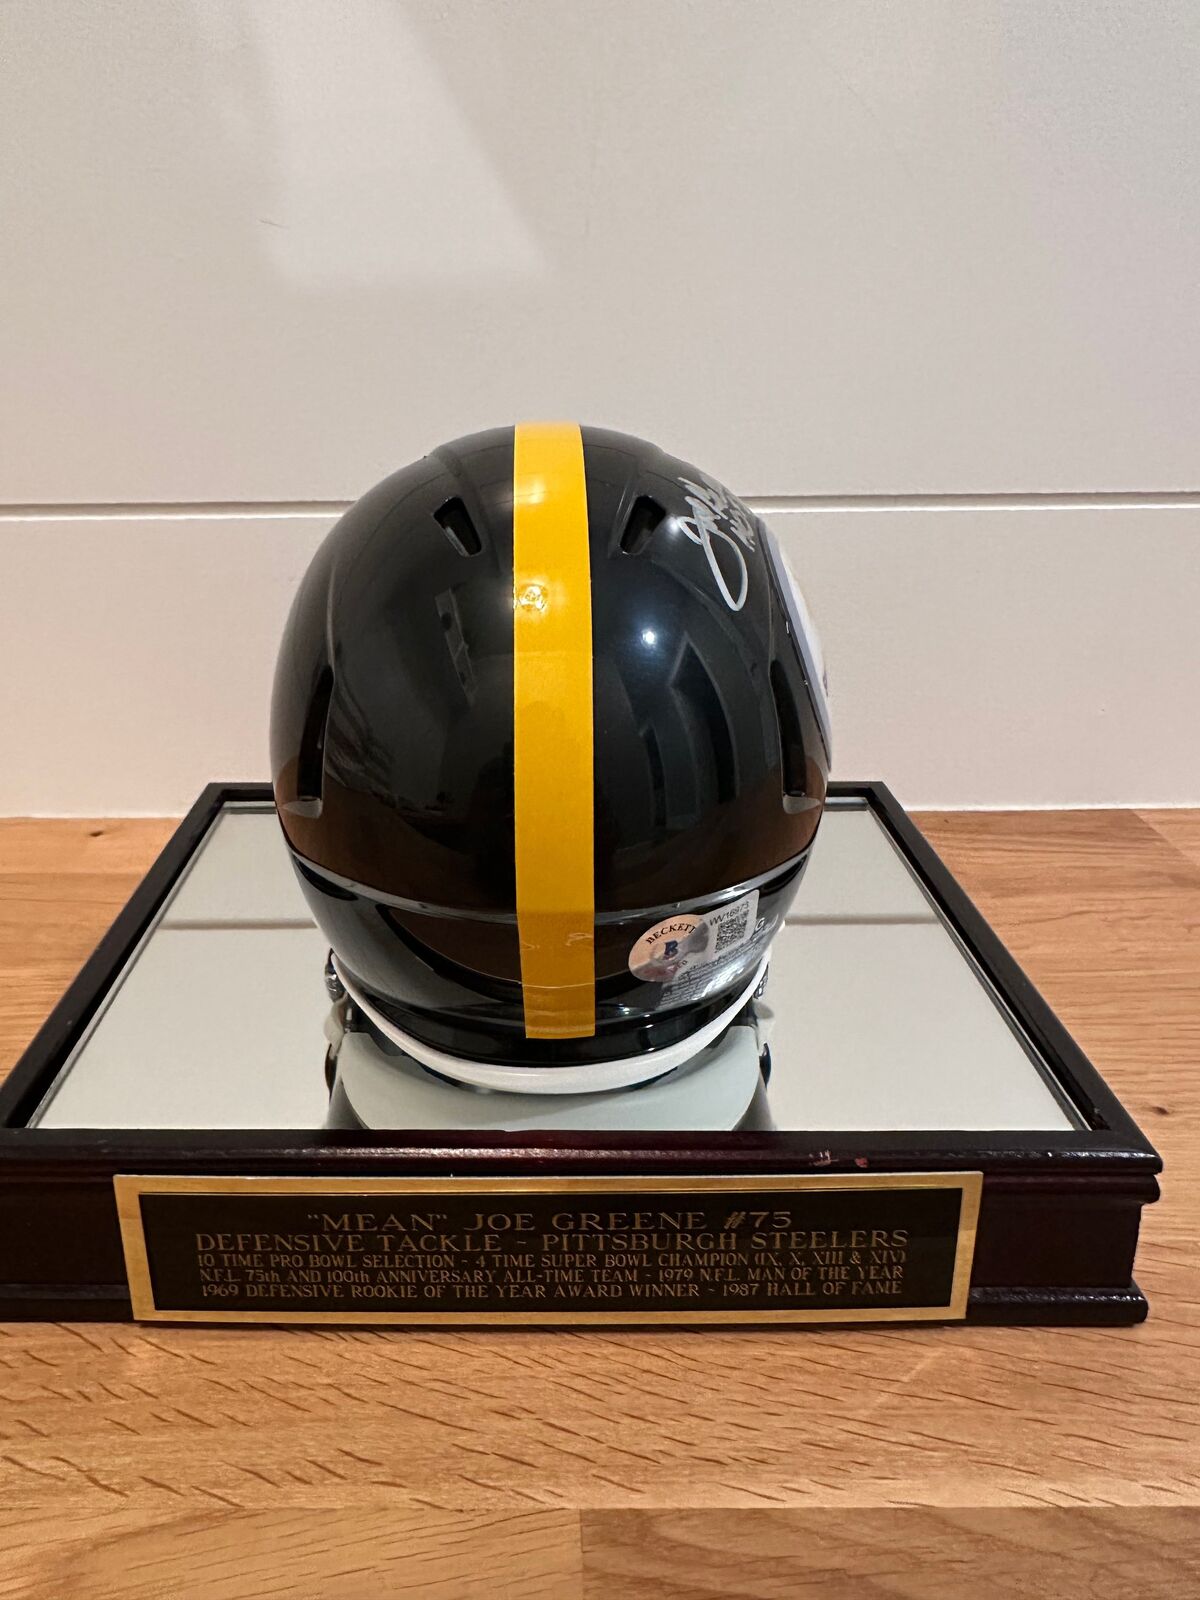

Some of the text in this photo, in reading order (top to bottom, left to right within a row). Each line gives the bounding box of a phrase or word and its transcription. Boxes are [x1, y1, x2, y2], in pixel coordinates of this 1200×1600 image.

[645, 922, 696, 945] BECKETT
[464, 1213, 535, 1231] JOE
[552, 1212, 707, 1230] GREENE
[724, 1211, 792, 1229] #75
[195, 1233, 364, 1252] DEFENSIVE
[377, 1234, 502, 1252] TACKLE
[542, 1232, 737, 1251] PITTSBURGH
[751, 1229, 909, 1249] STEELERS
[198, 1254, 215, 1267] 10
[222, 1254, 264, 1267] TIME
[270, 1254, 303, 1267] PRO
[309, 1255, 357, 1267] BOWL
[362, 1255, 455, 1268] SELECTION
[476, 1255, 486, 1267] 4
[492, 1254, 535, 1267] TIME
[541, 1254, 597, 1267] SUPER
[605, 1254, 652, 1267] BOWL
[658, 1252, 748, 1267] CHAMPION
[813, 1251, 843, 1265] XIII
[849, 1252, 861, 1264] &
[246, 1270, 280, 1282] 75th
[288, 1270, 321, 1282] AND
[328, 1270, 369, 1282] 100th
[377, 1270, 497, 1283] ANNIVERSARY
[504, 1269, 584, 1283] ALL-TIME
[591, 1269, 638, 1282] TEAM
[659, 1269, 693, 1282] 1979
[748, 1267, 785, 1280] MAN
[791, 1267, 812, 1280] OF
[818, 1266, 850, 1279] THE
[858, 1265, 904, 1279] YEAR
[202, 1284, 238, 1297] 1969
[246, 1284, 344, 1297] DEFENSIVE
[352, 1285, 418, 1298] ROOKIE
[424, 1285, 446, 1298] OF
[453, 1285, 488, 1298] THE
[496, 1285, 546, 1298] YEAR
[554, 1284, 622, 1297] AWARD
[630, 1284, 699, 1297] WINNER
[723, 1283, 760, 1297] 1987
[767, 1282, 815, 1296] HALL
[822, 1282, 845, 1295] OF
[852, 1281, 902, 1295] FAME
